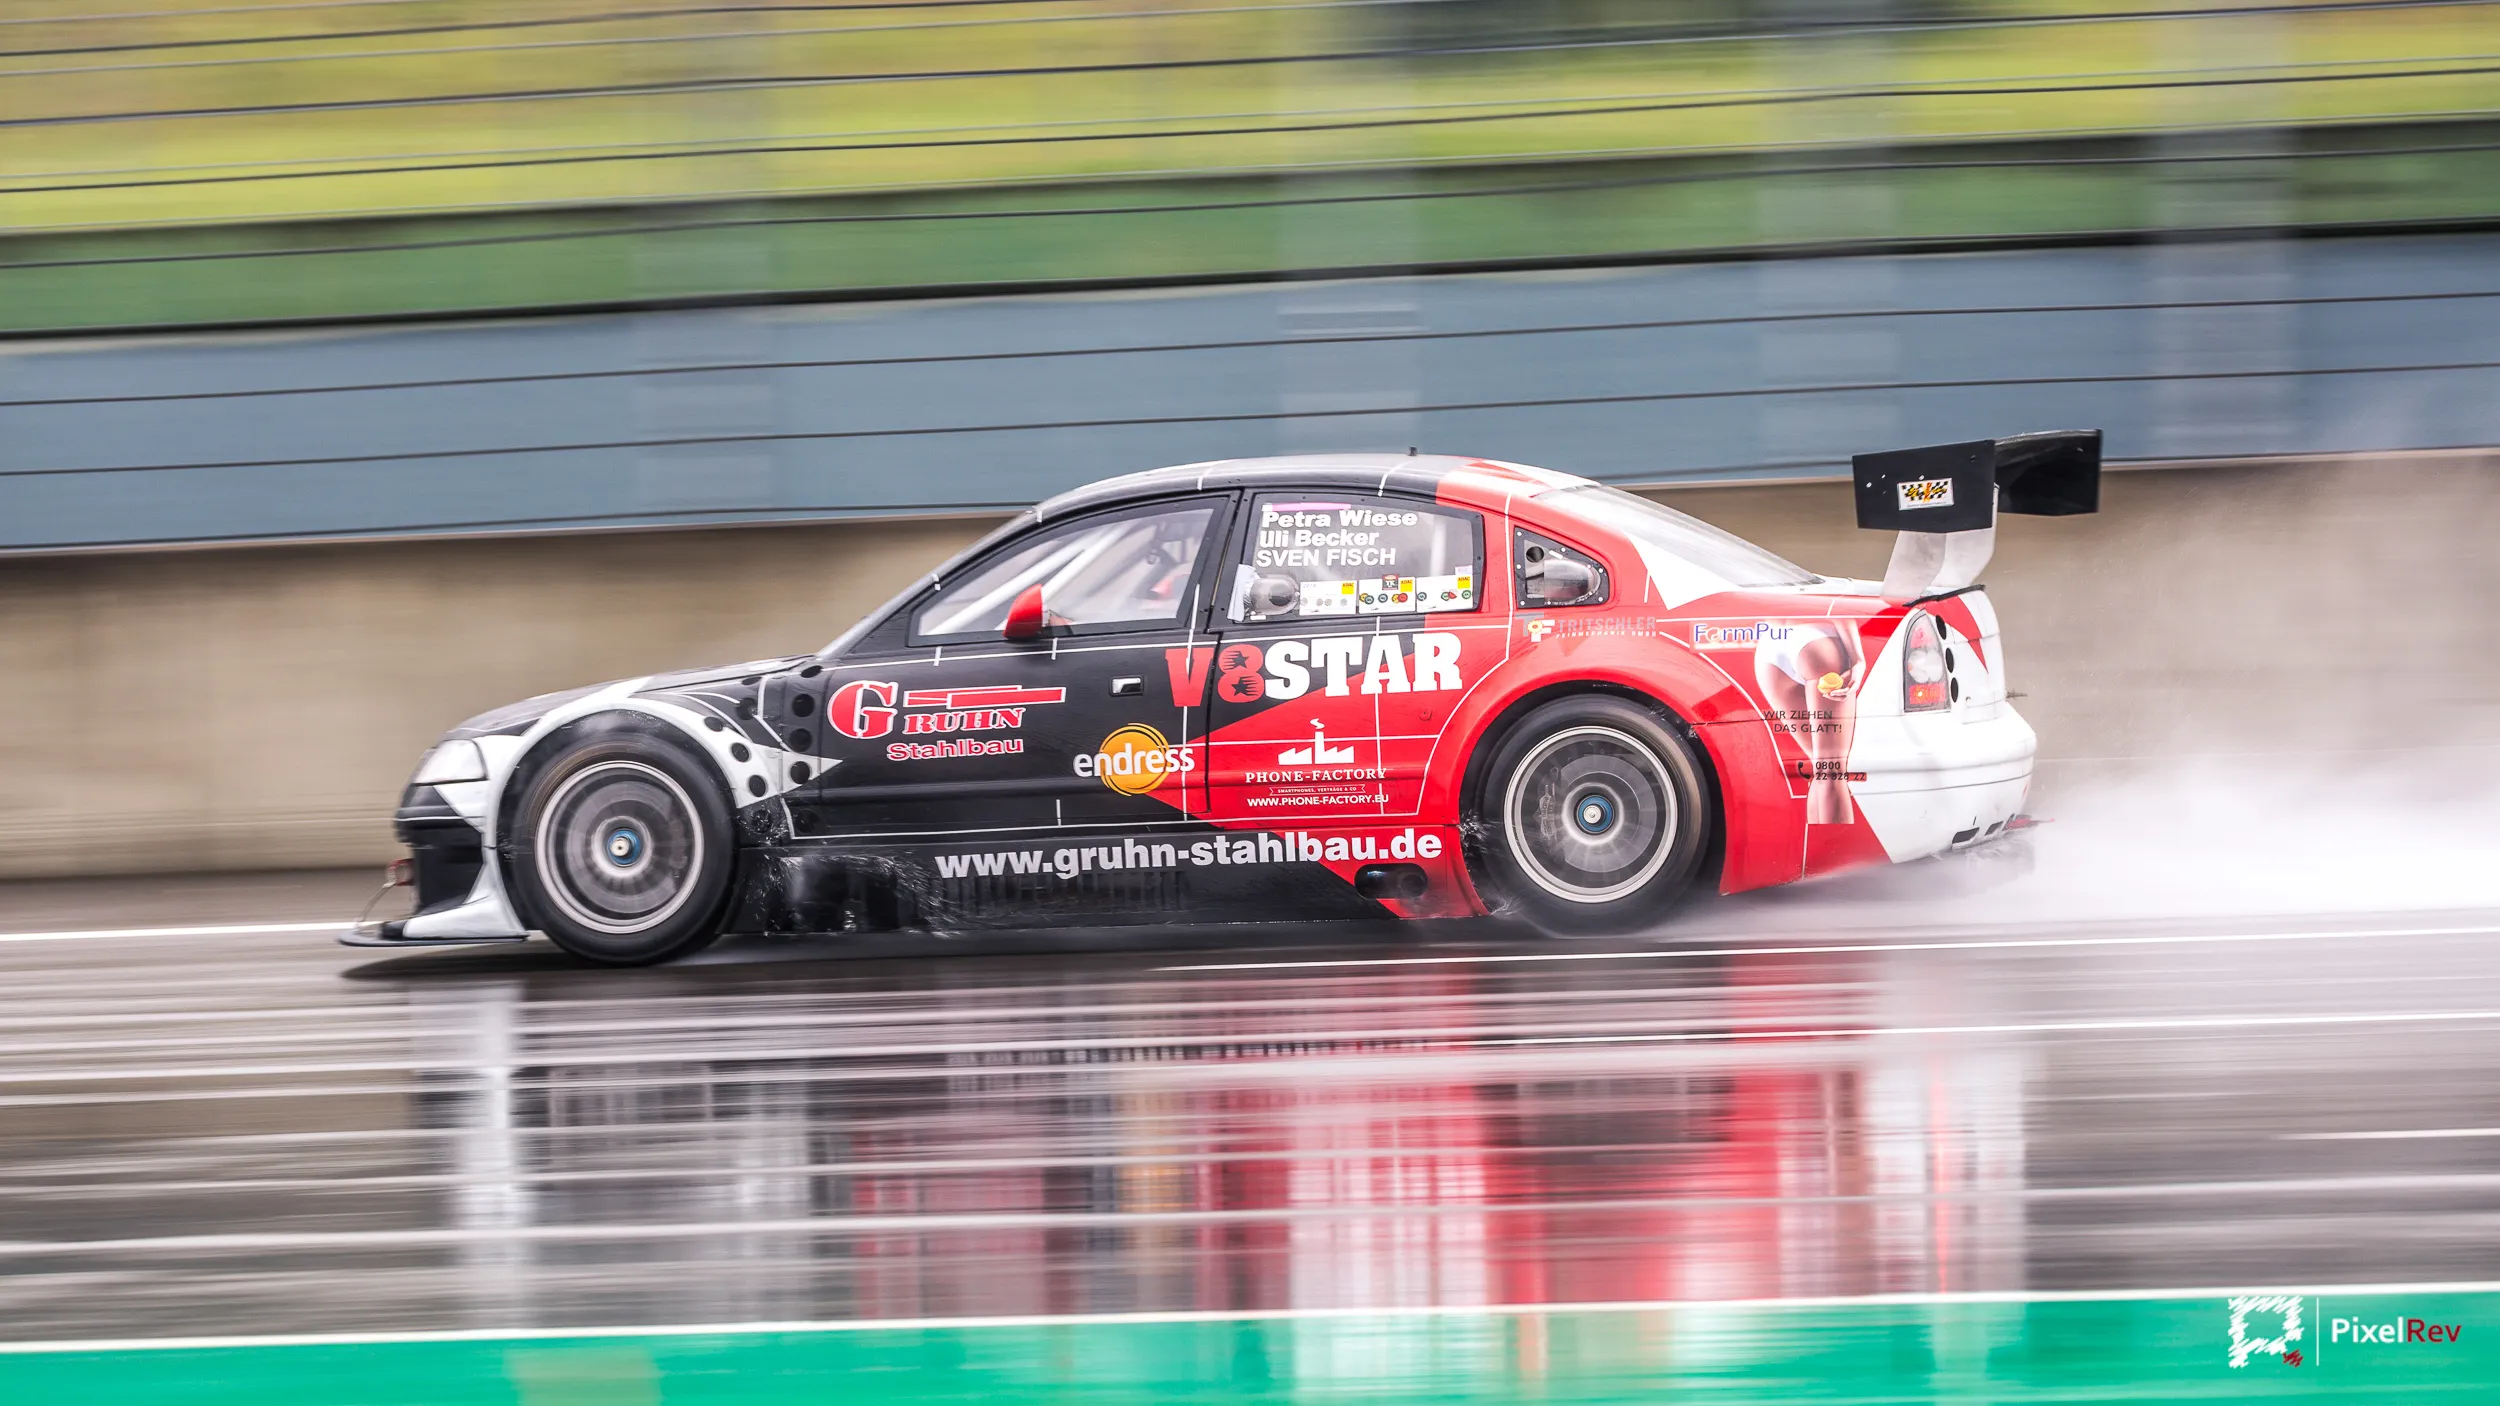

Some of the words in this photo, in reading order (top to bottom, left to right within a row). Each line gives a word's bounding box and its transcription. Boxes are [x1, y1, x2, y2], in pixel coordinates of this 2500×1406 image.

[1261, 511, 1331, 527] Petra
[1338, 510, 1418, 527] Wiese
[1259, 530, 1288, 548] Uli
[1295, 529, 1379, 547] Becker
[1256, 550, 1319, 567] SVEN
[1326, 548, 1396, 566] FISCH
[1558, 616, 1656, 632] TRITSCHLER
[1694, 622, 1794, 642] FormPur
[1165, 632, 1462, 707] V8STAR
[1763, 710, 1786, 720] WIR
[1790, 710, 1833, 720] ZIEHEN
[1774, 724, 1797, 733] DAS
[1801, 723, 1842, 733] GLATT!
[887, 739, 1024, 761] Stahlbau
[1073, 742, 1195, 777] endress
[1815, 761, 1841, 770] 0800
[1245, 768, 1387, 783] PHONE-FACTORY
[1816, 772, 1827, 781] 22
[1854, 772, 1865, 781] 22
[1247, 794, 1389, 807] WWW.PHONE-FACTORY.EU
[935, 828, 1443, 880] www.gruhn-stahlbau.de
